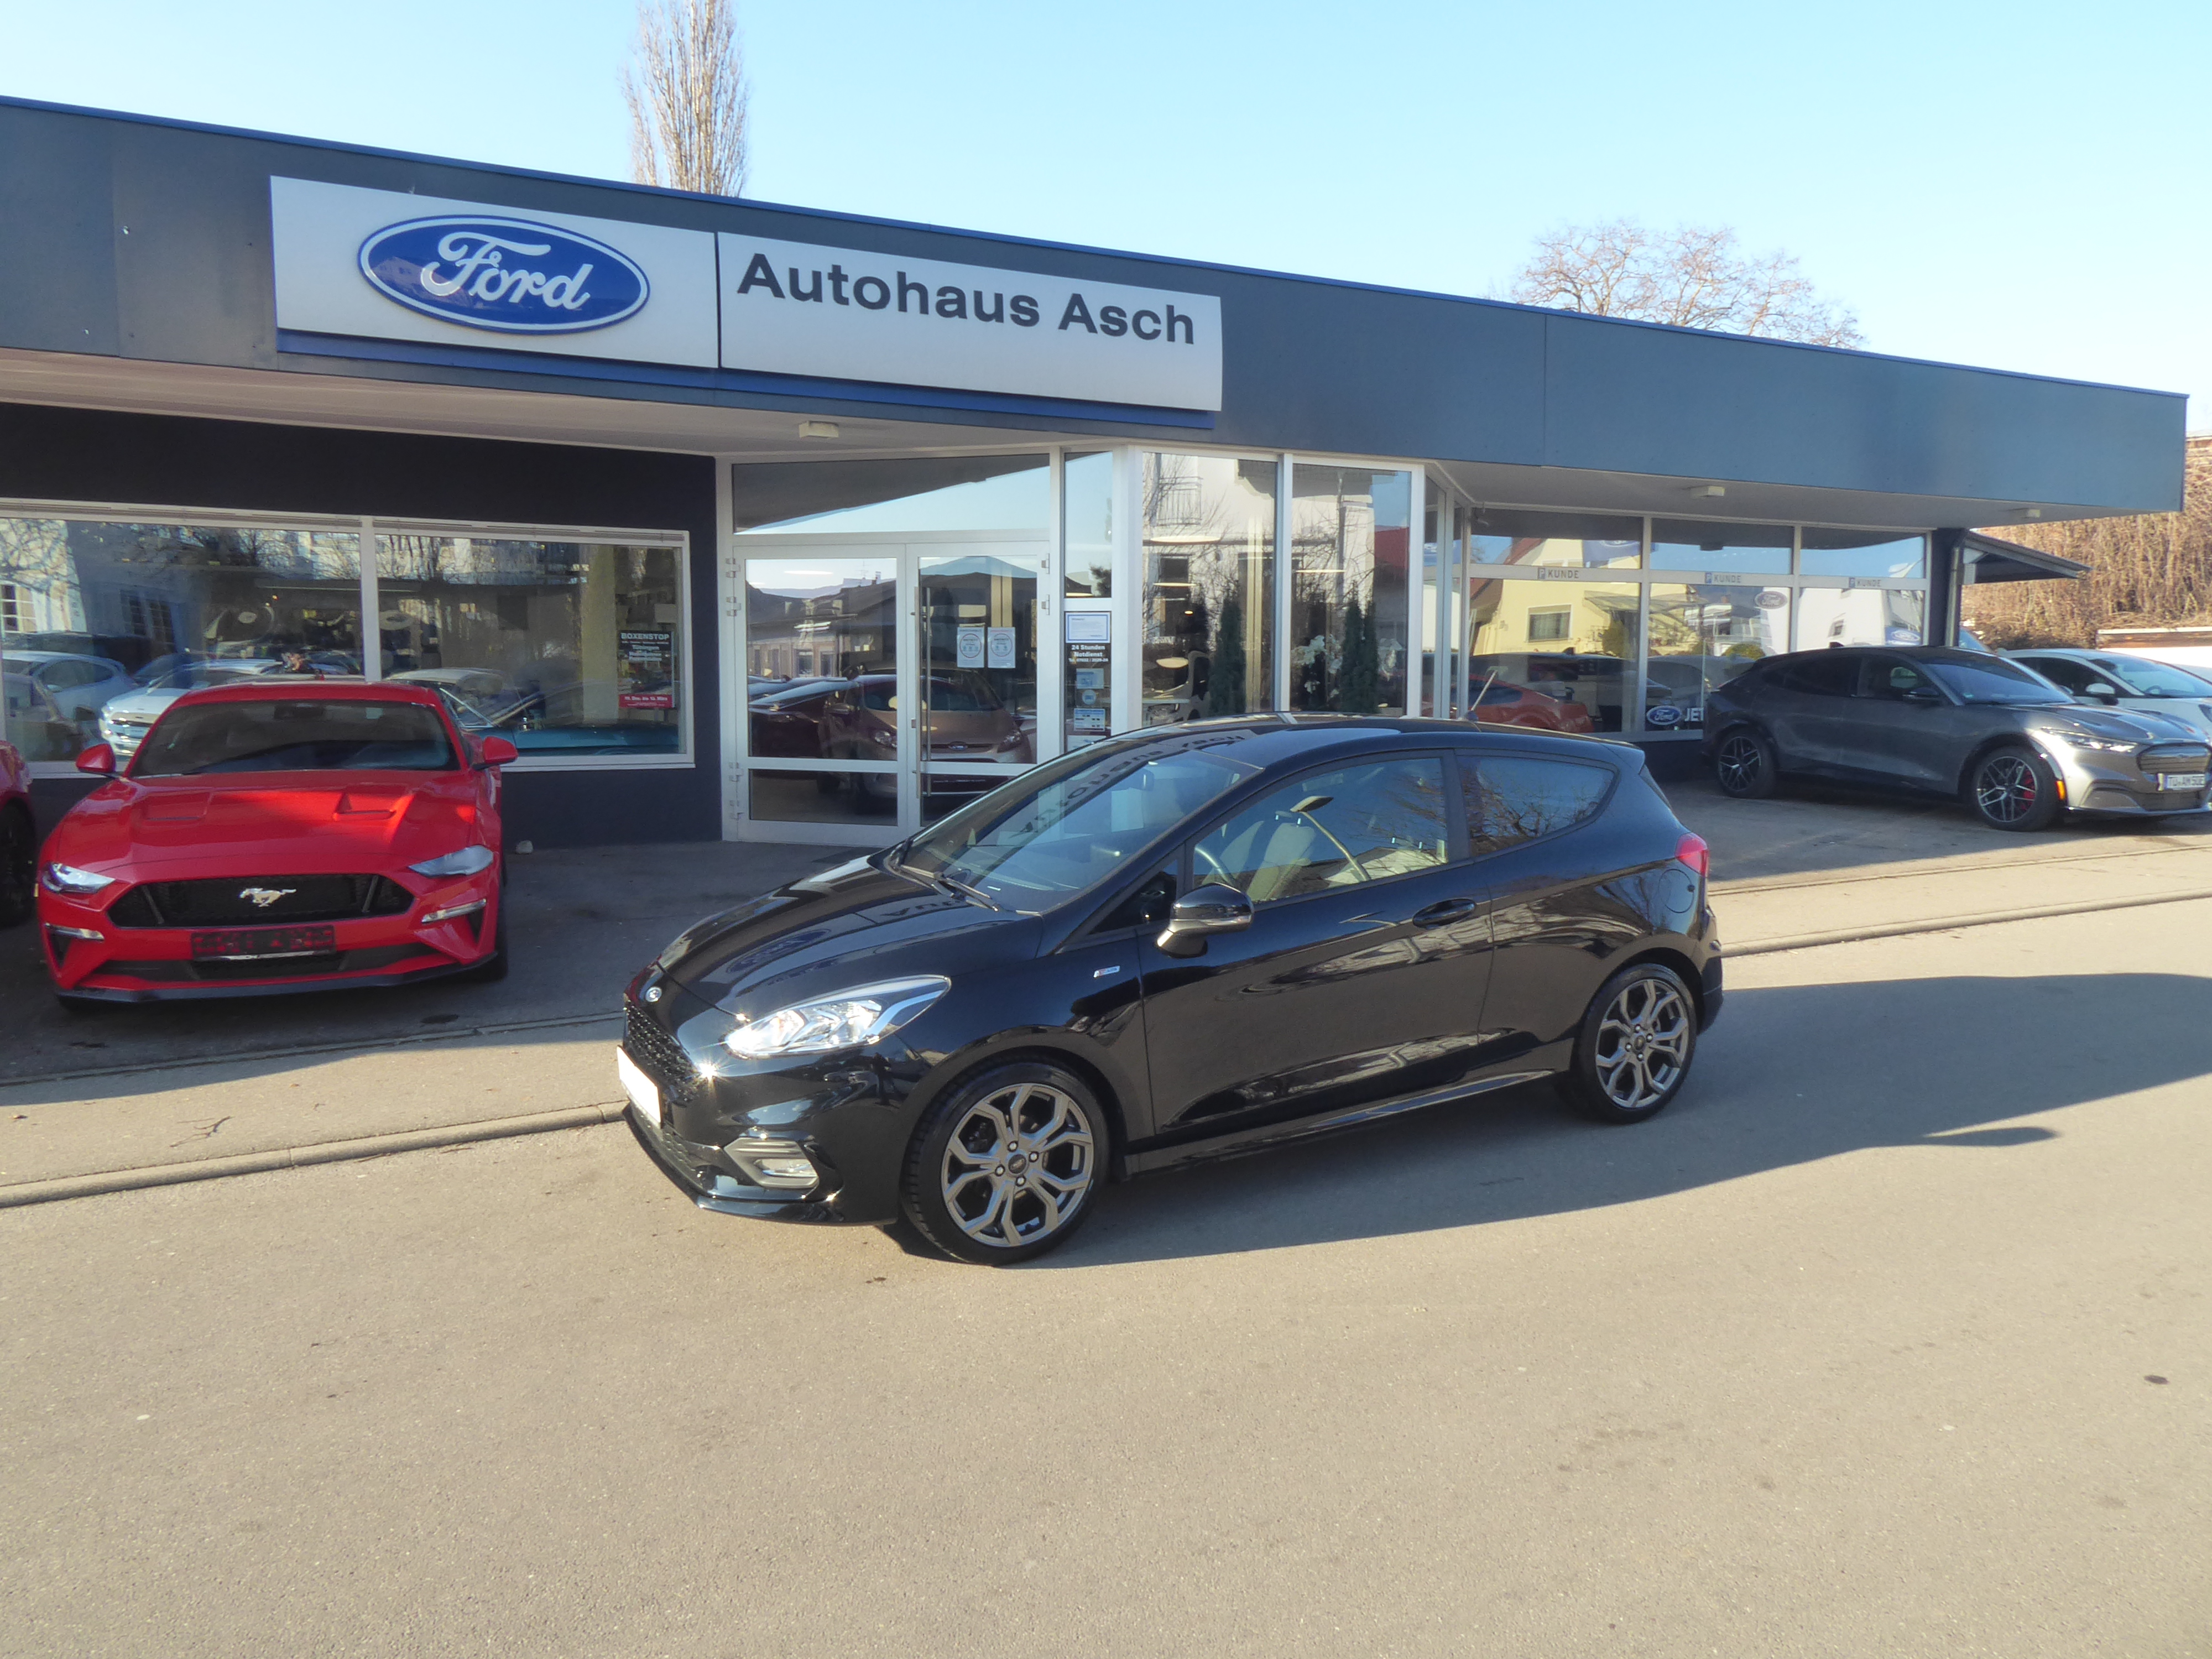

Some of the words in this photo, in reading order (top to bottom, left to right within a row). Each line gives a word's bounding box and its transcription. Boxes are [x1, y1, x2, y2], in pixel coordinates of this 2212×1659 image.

[420, 231, 594, 310] Ford
[737, 253, 1040, 327] Autohaus
[1058, 293, 1195, 345] Asch
[1547, 569, 1579, 578] KUNDE
[1714, 574, 1741, 583] KUNDE
[1857, 579, 1881, 587] KUNDE
[1654, 709, 1674, 721] Ford
